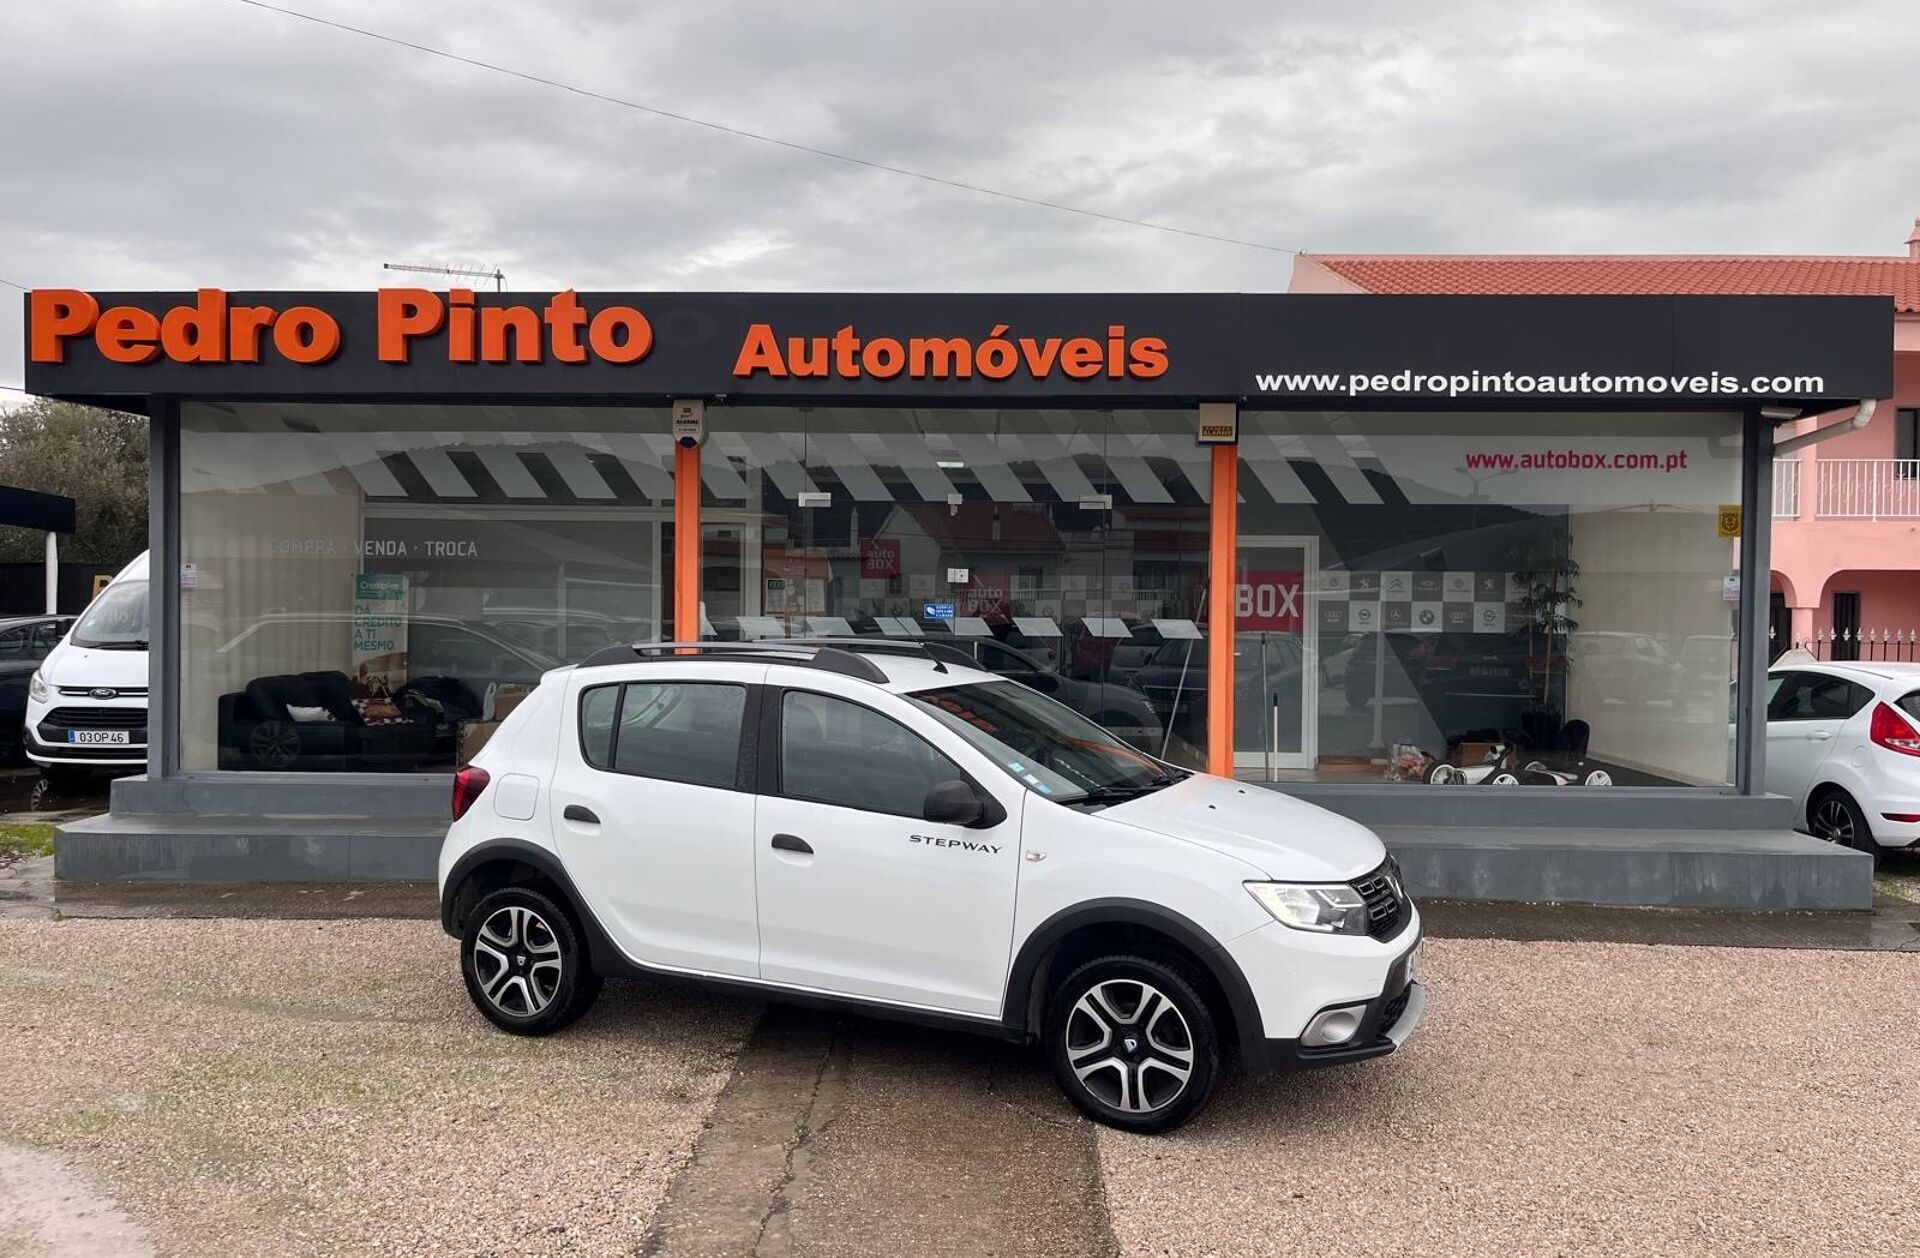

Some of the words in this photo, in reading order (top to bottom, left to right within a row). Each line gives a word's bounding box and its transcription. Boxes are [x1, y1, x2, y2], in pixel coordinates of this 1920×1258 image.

[31, 288, 341, 364] Pedro
[378, 288, 653, 364] Pinto
[733, 323, 1169, 378] Automóveis
[1255, 370, 1825, 397] www.pedropintoautomoveis.com
[1465, 451, 1688, 473] www.autobox.com.pt
[271, 541, 337, 555] COMPRA
[353, 541, 407, 556] VENDA
[424, 541, 478, 556] TROCA
[866, 549, 895, 559] auto
[967, 586, 1003, 598] auto
[1236, 584, 1300, 618] BOX
[354, 629, 363, 639] A
[366, 629, 377, 639] TI
[909, 834, 1003, 854] STEPWAY
